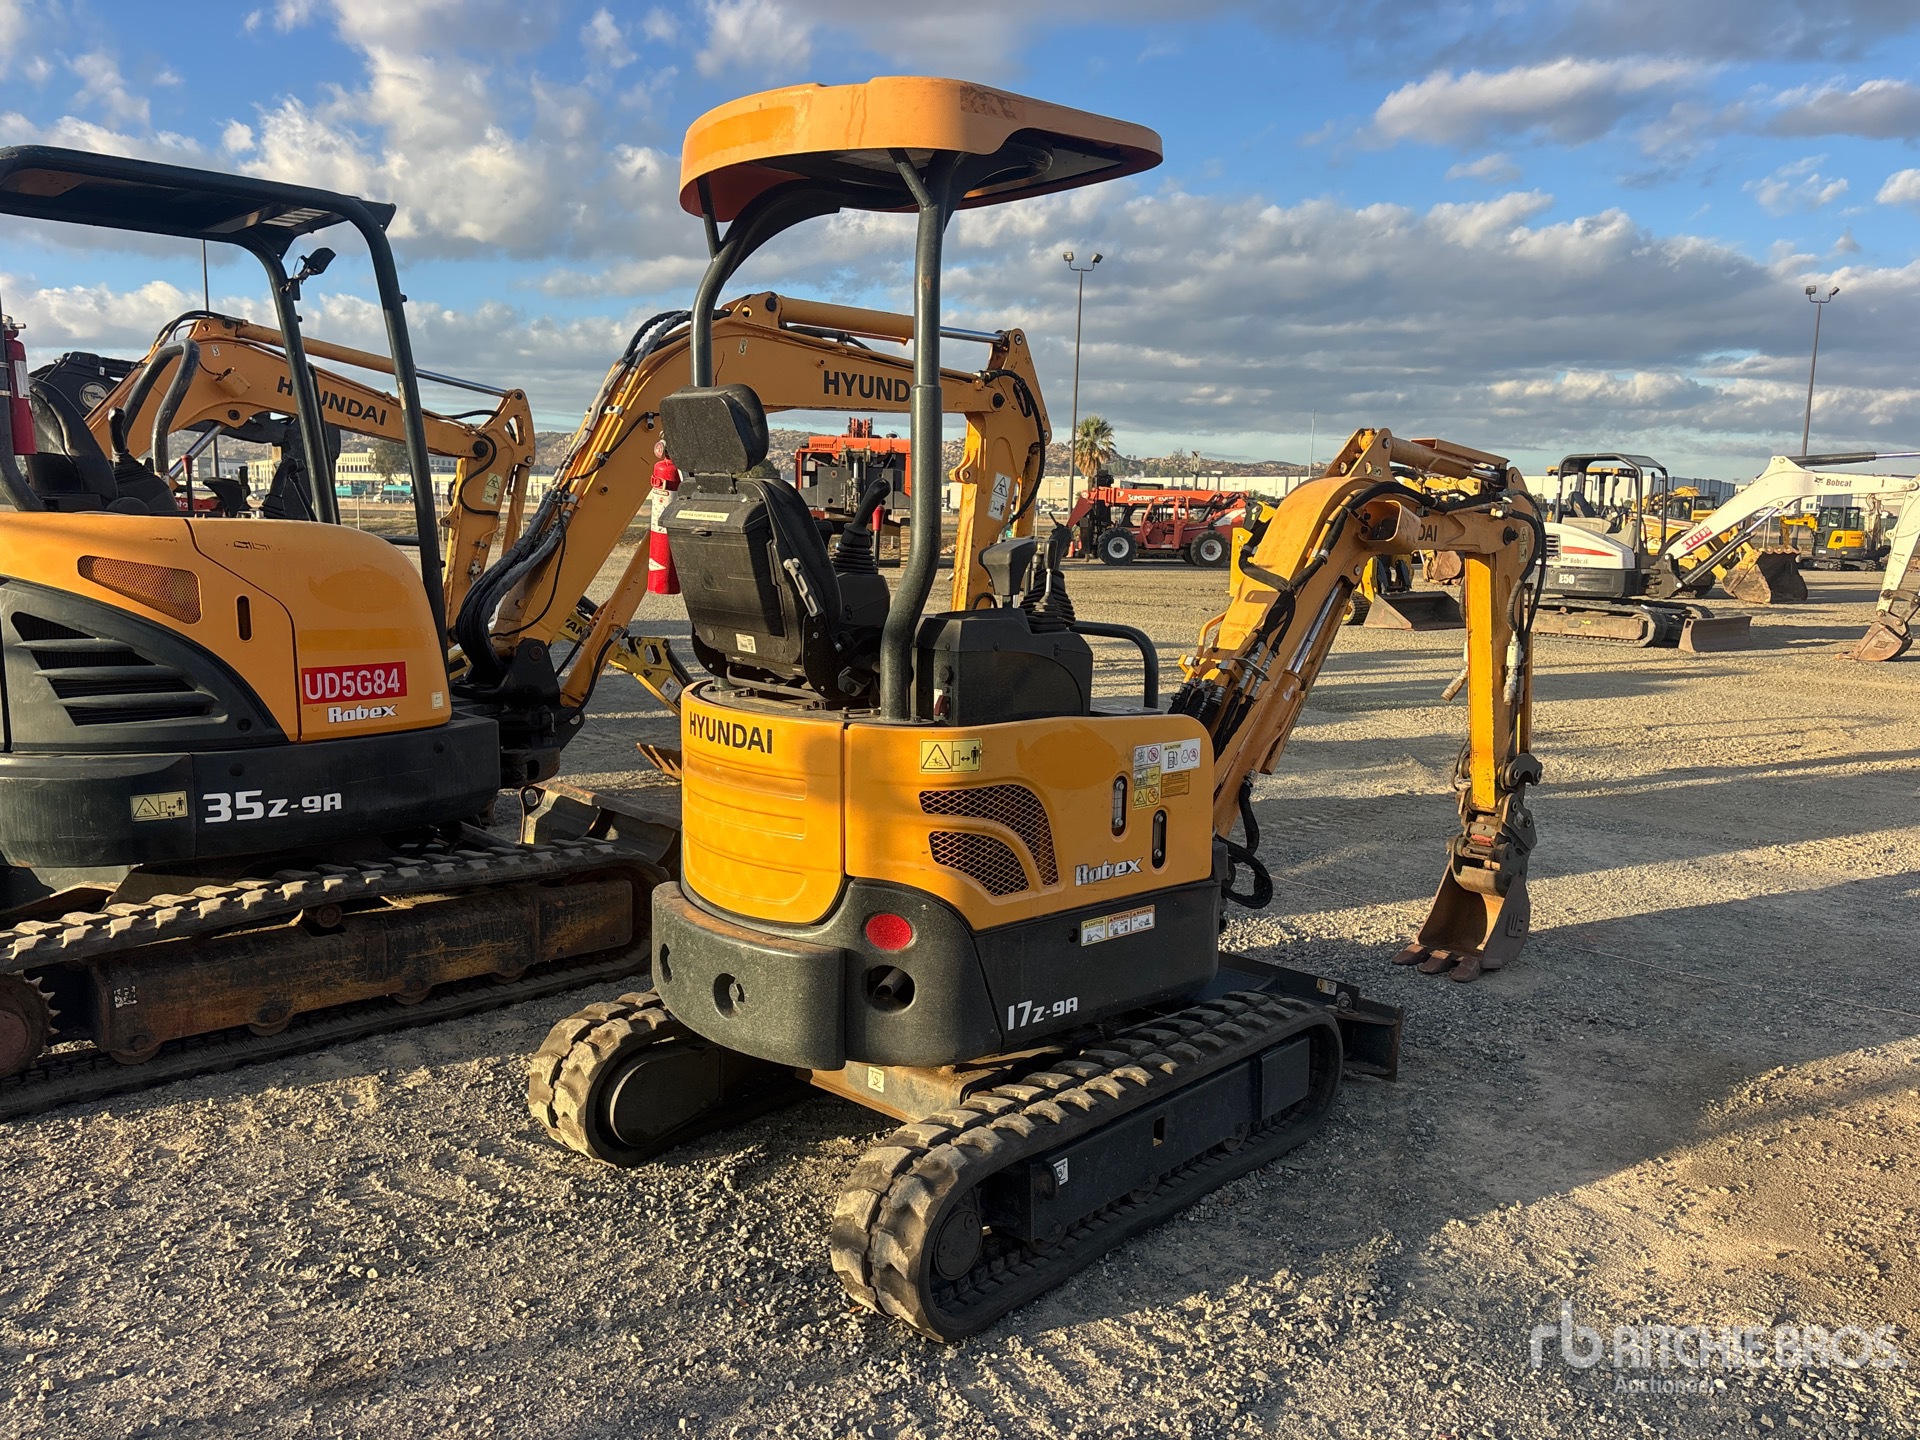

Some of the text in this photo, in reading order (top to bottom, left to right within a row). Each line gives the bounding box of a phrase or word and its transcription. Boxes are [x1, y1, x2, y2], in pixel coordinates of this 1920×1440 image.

[276, 375, 387, 426] HUNDAI
[1826, 478, 1852, 487] Bobcat
[1558, 574, 1575, 585] E50
[304, 668, 400, 701] UD5G84
[689, 711, 773, 754] HYUNDAI
